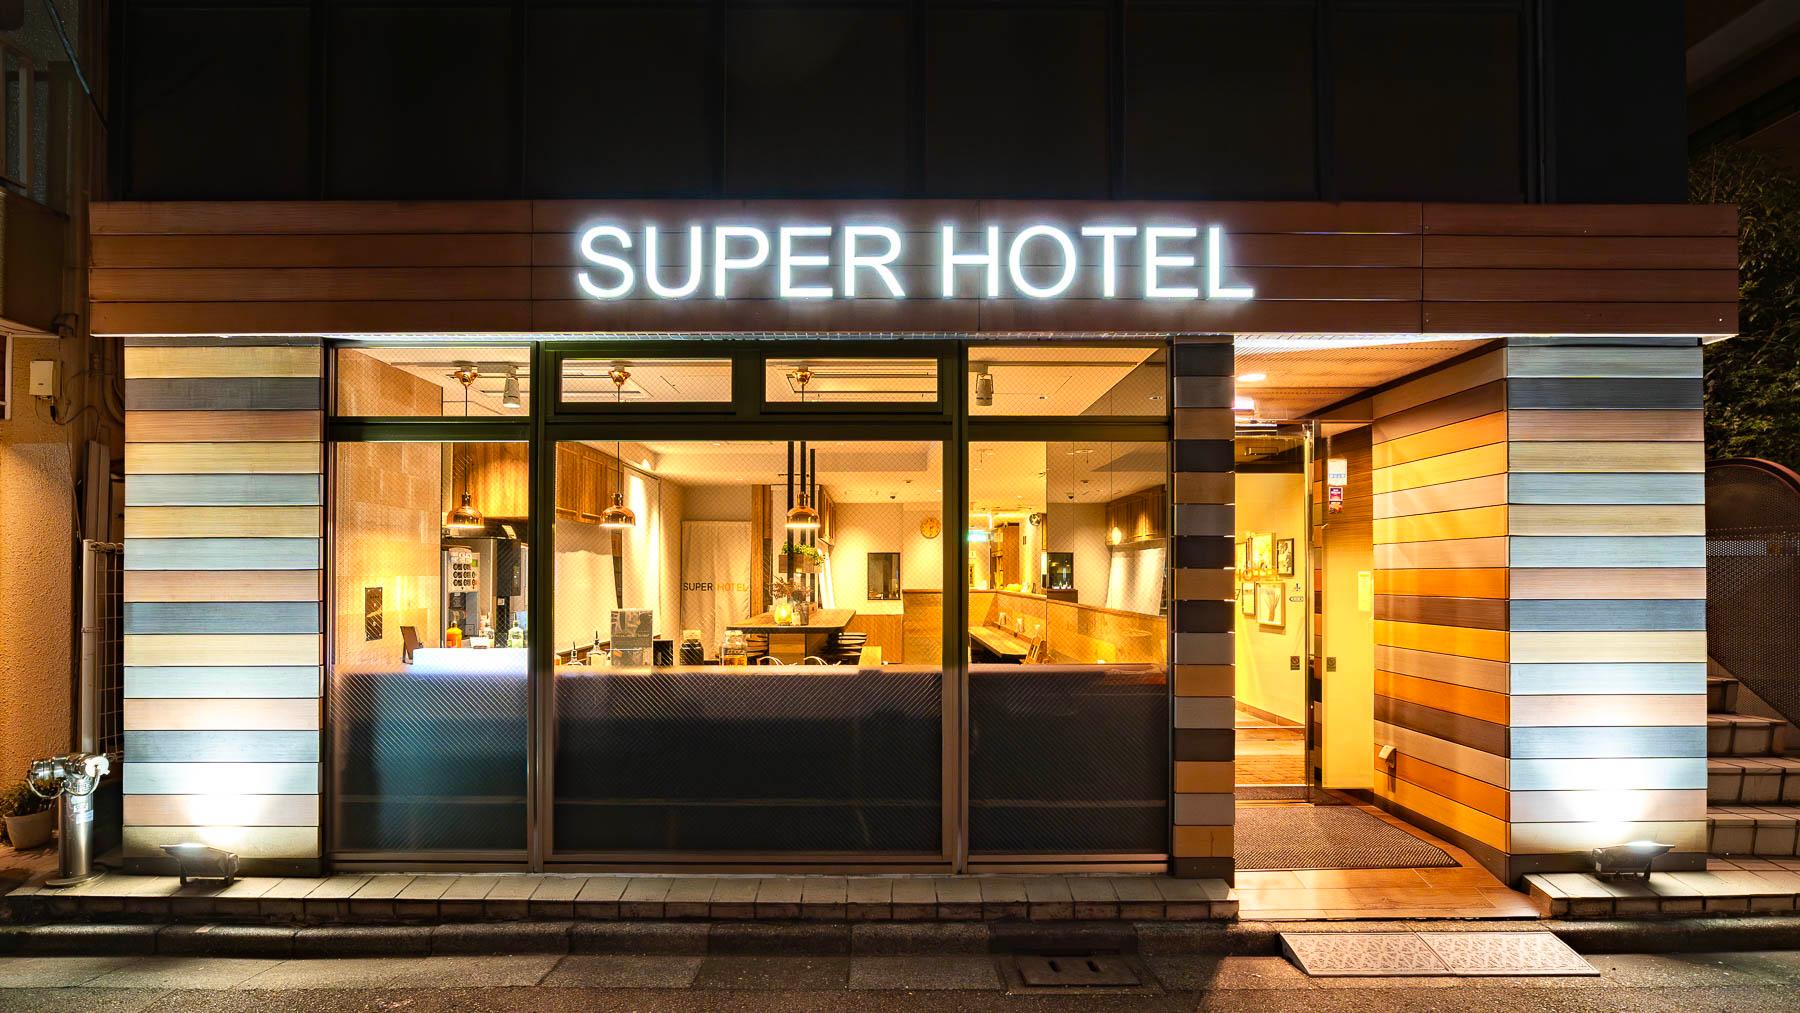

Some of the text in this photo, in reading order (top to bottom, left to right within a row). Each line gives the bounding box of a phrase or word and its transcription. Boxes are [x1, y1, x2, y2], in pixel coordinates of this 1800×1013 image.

[577, 225, 1255, 298] SUPER HOTEL
[683, 582, 748, 592] SUPER HOTEL
